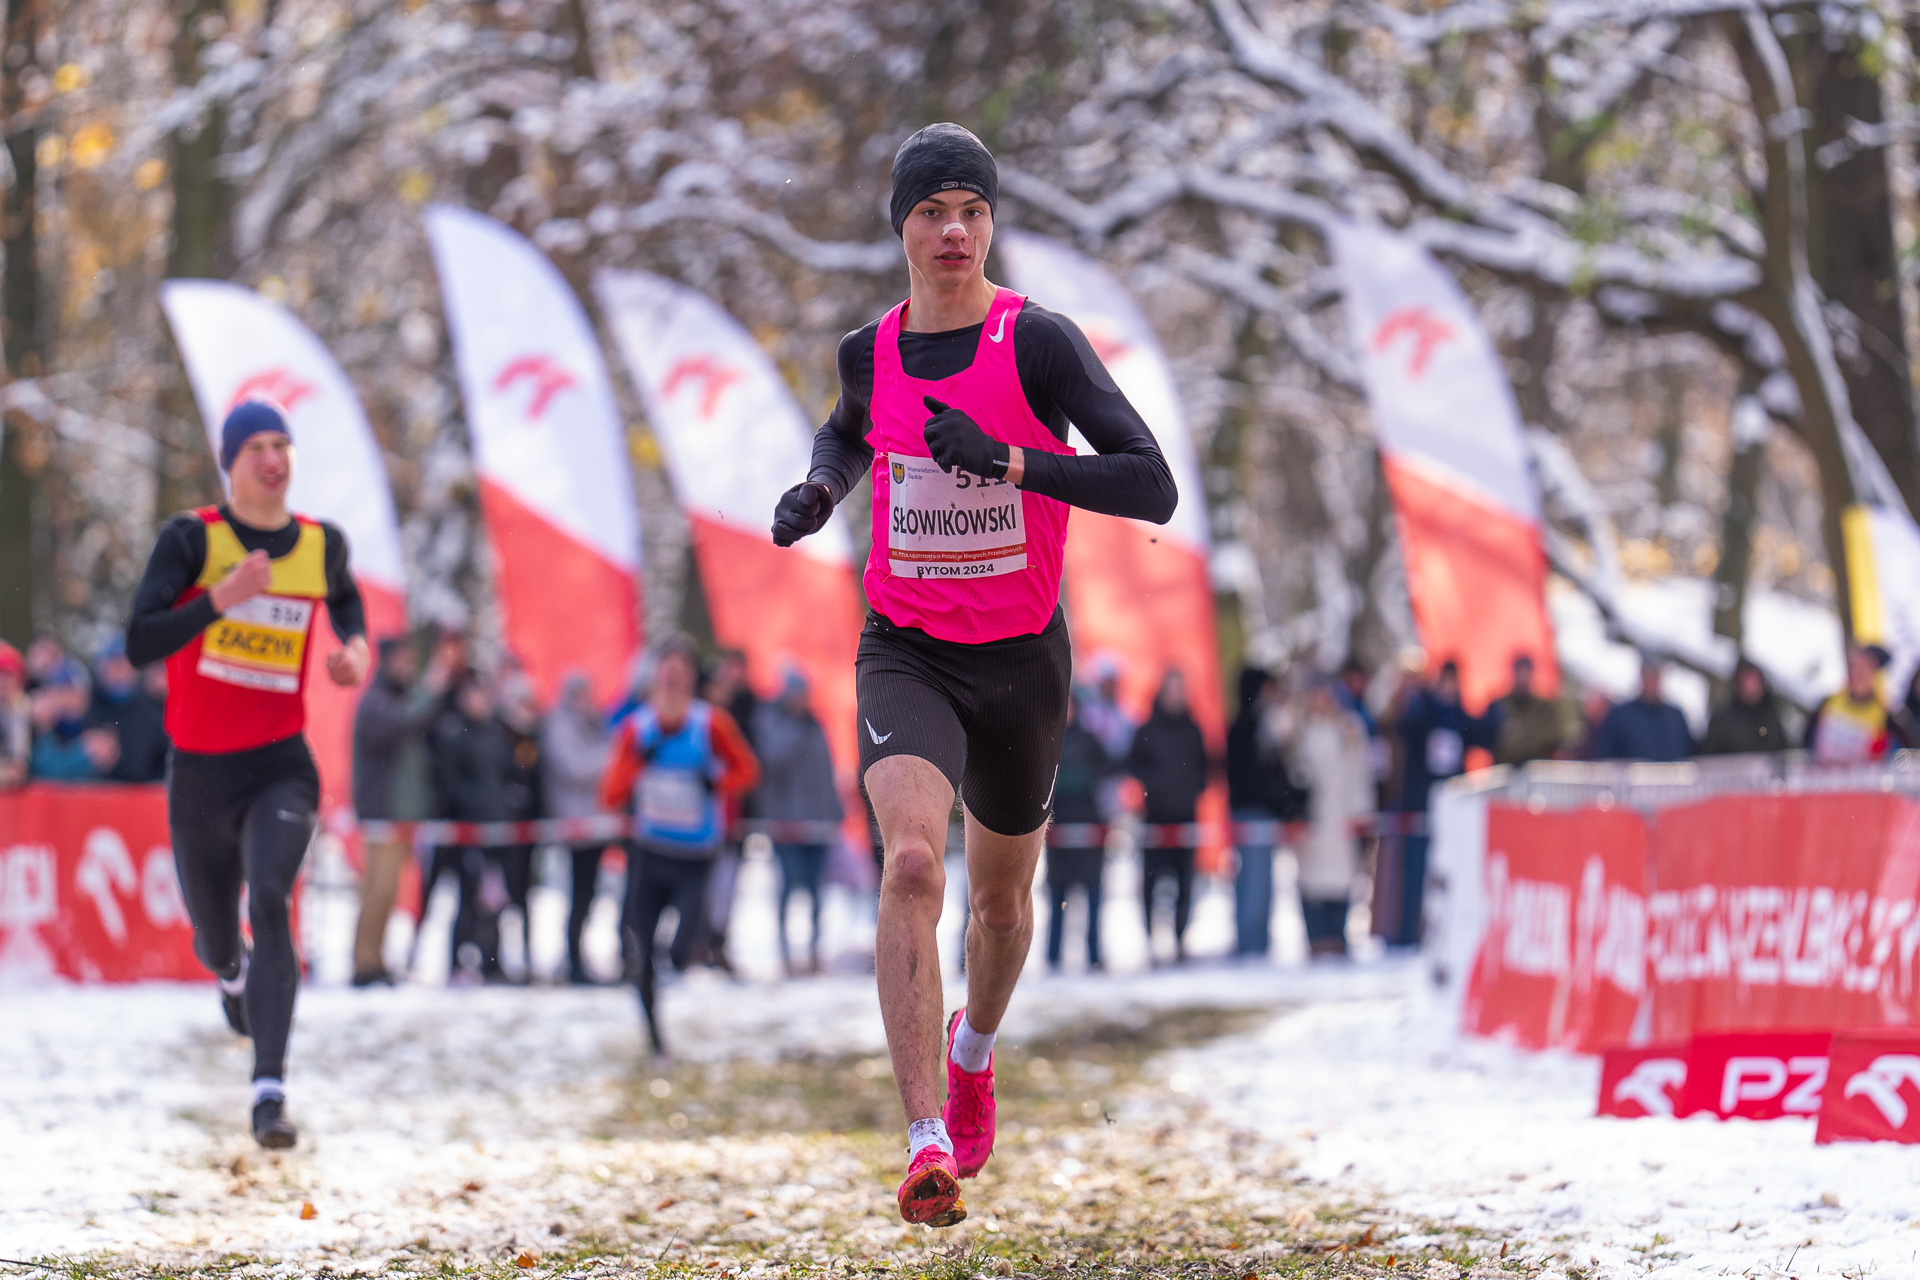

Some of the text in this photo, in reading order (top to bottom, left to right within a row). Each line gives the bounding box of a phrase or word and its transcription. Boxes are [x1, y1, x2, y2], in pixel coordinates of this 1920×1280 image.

[893, 503, 1017, 536] SŁOWIKOWSKI
[964, 551, 987, 559] Biegach
[917, 563, 995, 576] BYTOM 2024
